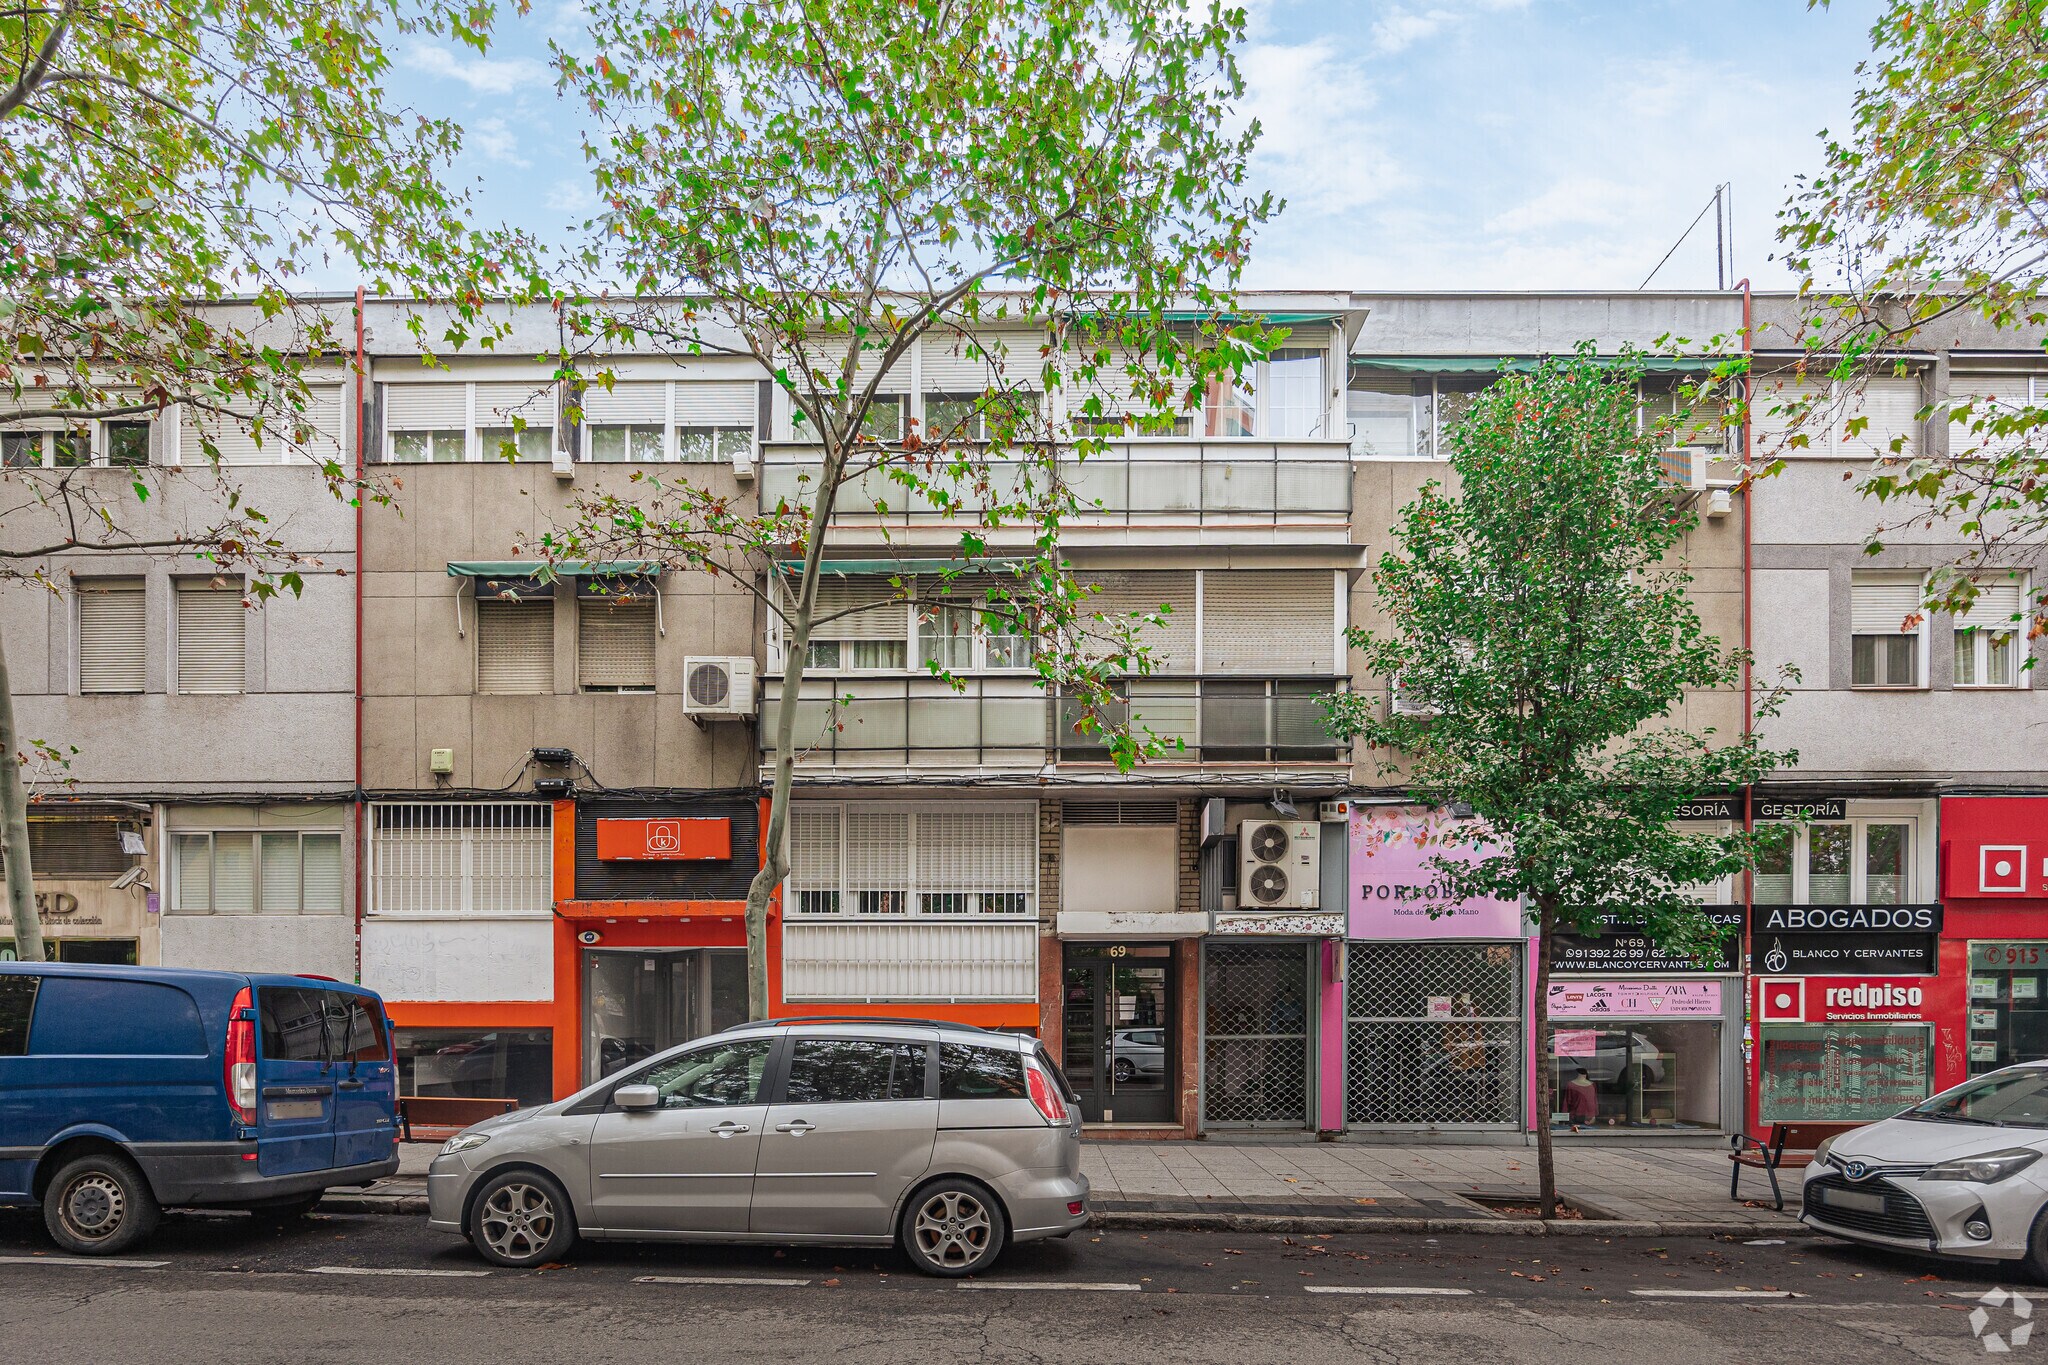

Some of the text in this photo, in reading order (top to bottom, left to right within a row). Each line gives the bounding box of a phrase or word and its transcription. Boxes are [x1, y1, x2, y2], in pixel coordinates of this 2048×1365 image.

[1761, 803, 1840, 816] GESTORÍA
[1415, 908, 1424, 916] de
[1458, 908, 1479, 916] Mano
[1766, 909, 1933, 929] ABOGADOS
[1110, 945, 1126, 957] 69
[1793, 949, 1924, 958] BLANCO Y CERVANTES
[1665, 985, 1687, 995] ZARA
[1826, 983, 1923, 1009] redpiso
[1826, 1012, 1922, 1021] Servicios Inmobiliarios
